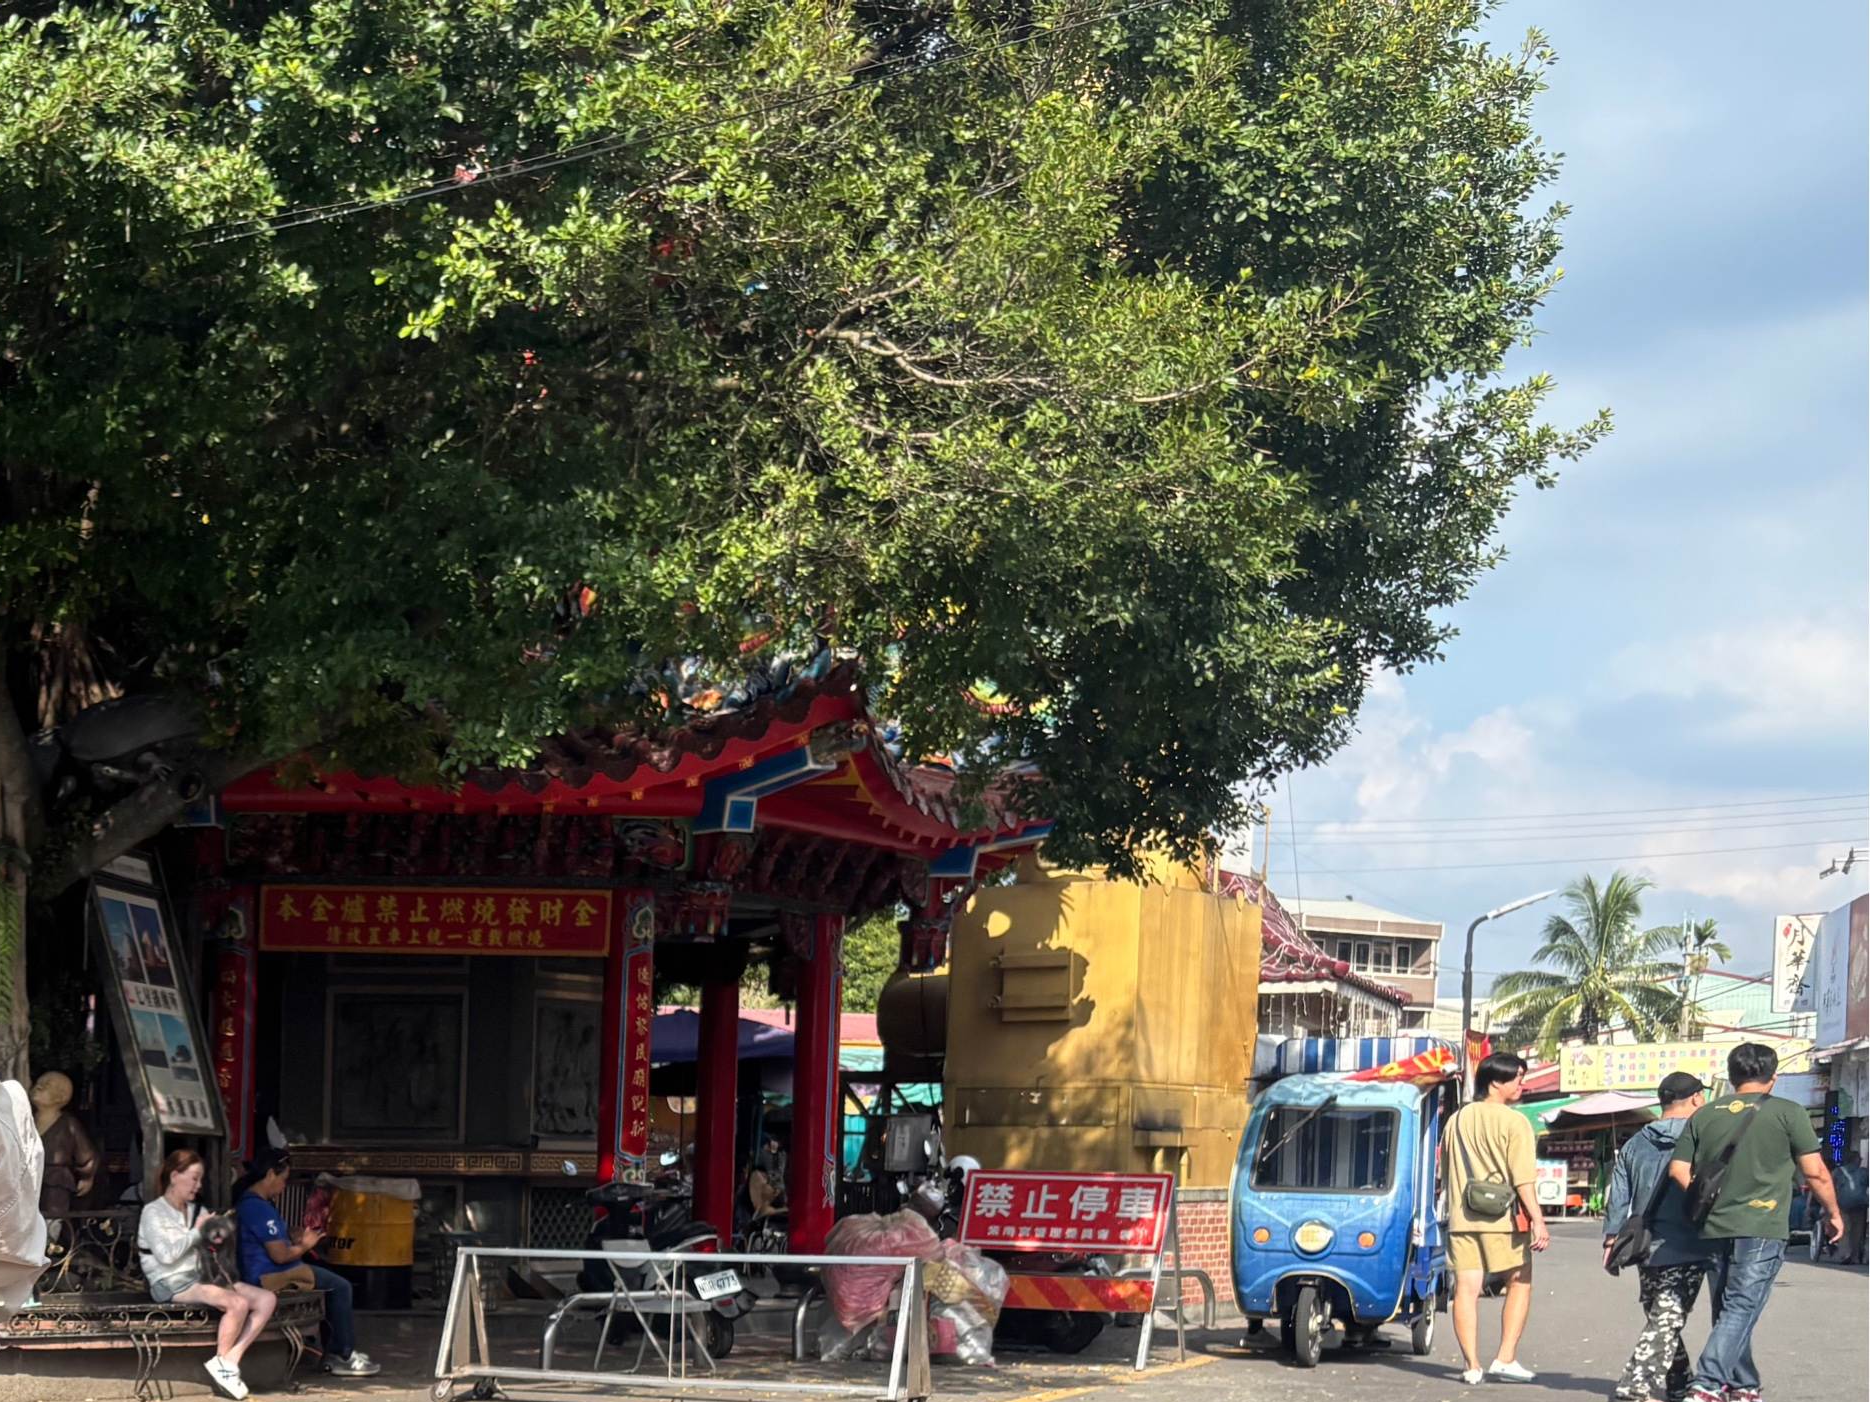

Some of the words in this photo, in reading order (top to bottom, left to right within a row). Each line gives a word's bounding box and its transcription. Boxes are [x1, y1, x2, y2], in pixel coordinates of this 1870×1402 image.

[276, 894, 599, 927] 本金爐禁止燃燒發財金
[975, 1183, 1156, 1221] 禁止停車
